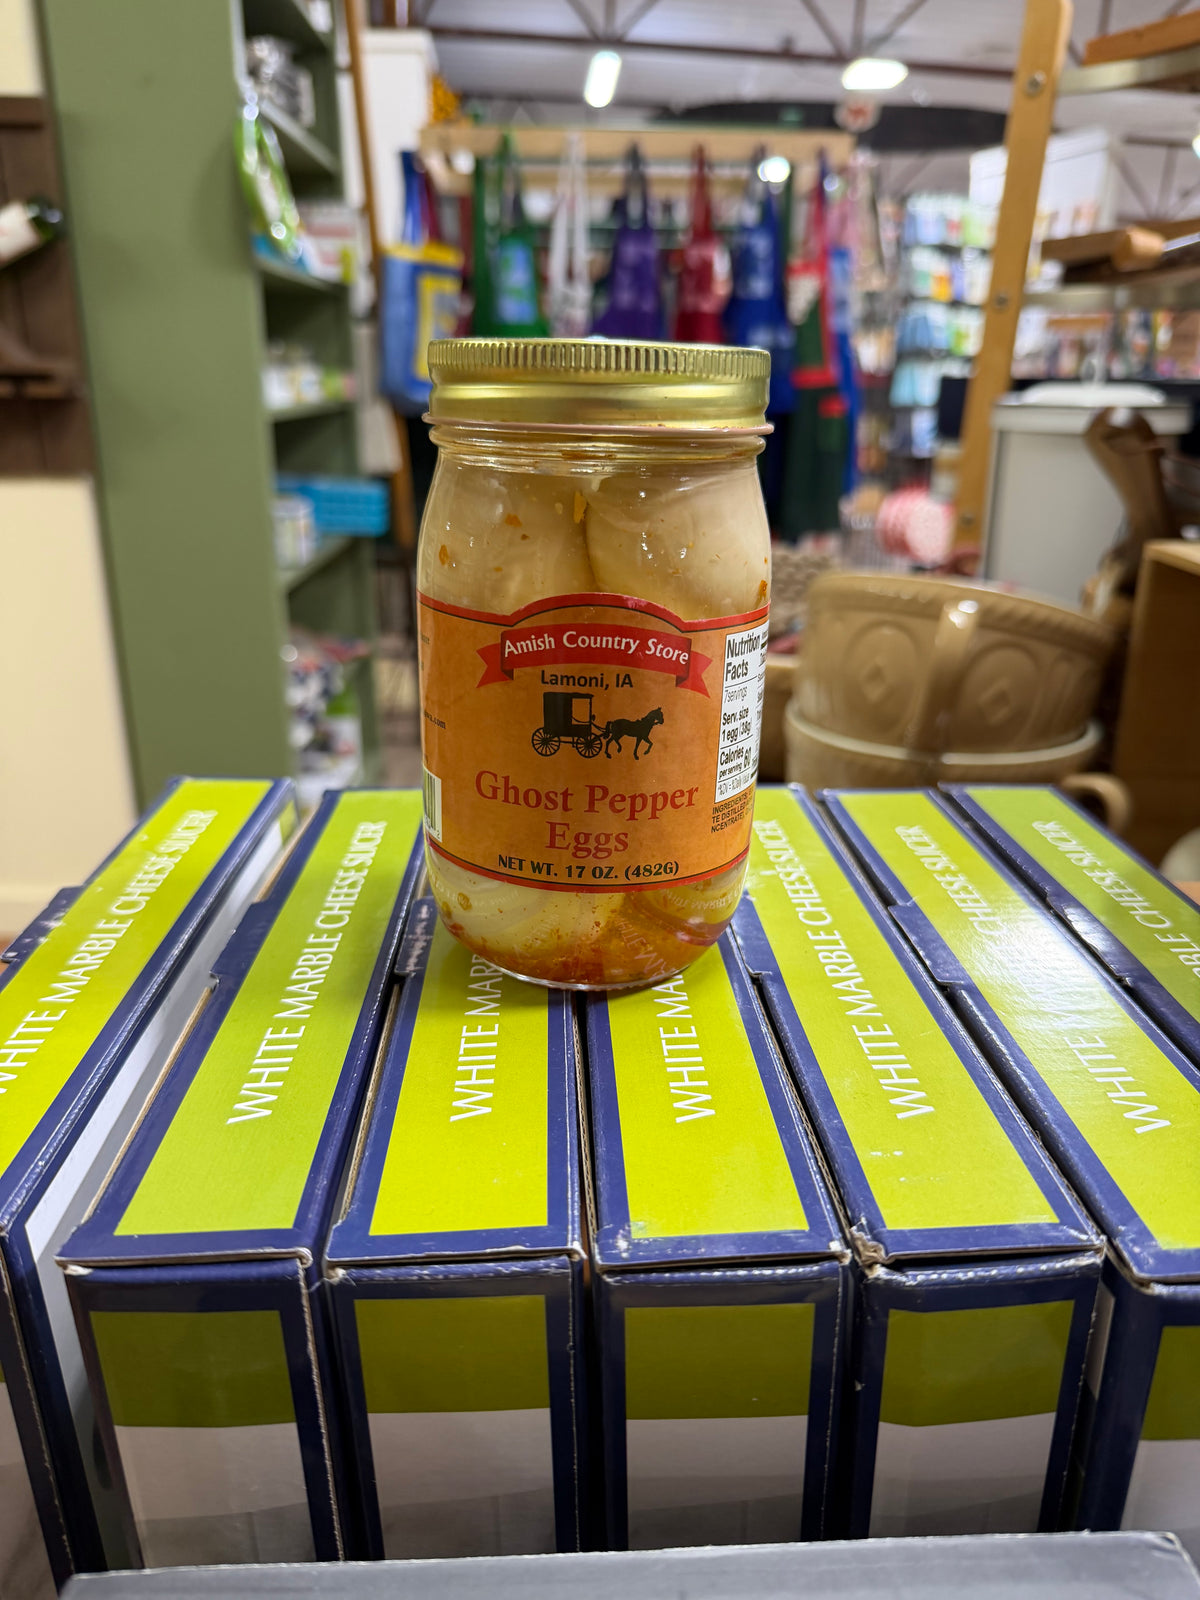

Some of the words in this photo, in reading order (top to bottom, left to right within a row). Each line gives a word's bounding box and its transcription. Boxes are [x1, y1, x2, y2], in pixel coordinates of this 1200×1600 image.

[504, 633, 555, 658] Amish
[562, 631, 640, 655] Country
[645, 638, 690, 665] Store
[726, 632, 761, 659] Nutrition
[540, 670, 610, 690] Lamoni,
[615, 673, 634, 688] IA
[725, 659, 749, 682] Facts
[721, 728, 726, 742] 1
[726, 727, 739, 743] egg
[722, 711, 738, 726] Serv.
[720, 745, 745, 766] Calories
[475, 770, 574, 813] Ghost
[583, 784, 699, 821] Pepper
[341, 820, 388, 868] SLICER
[545, 820, 630, 860] Eggs
[752, 819, 801, 864] SLICER
[895, 825, 958, 872] SLICER
[1031, 820, 1102, 867] SLICER
[498, 853, 526, 872] NET
[530, 860, 558, 877] WT.
[565, 865, 586, 879] 17
[591, 866, 619, 879] OZ.
[624, 860, 680, 881] (482G)
[315, 868, 369, 929] CHEESE
[774, 864, 833, 926] CHEESE
[932, 872, 1009, 936] CHEESE
[1082, 867, 1173, 929] CHEESE
[39, 918, 135, 1003] MARBLE
[110, 854, 183, 915] CHEESE
[273, 932, 342, 1020] MARBLE
[806, 929, 884, 1017] MARBLE
[226, 1025, 306, 1125] WHITE
[449, 1023, 500, 1122] WHITE
[659, 1025, 716, 1123] WHITE
[852, 1023, 935, 1119] WHITE
[1063, 1035, 1171, 1134] WHITE
